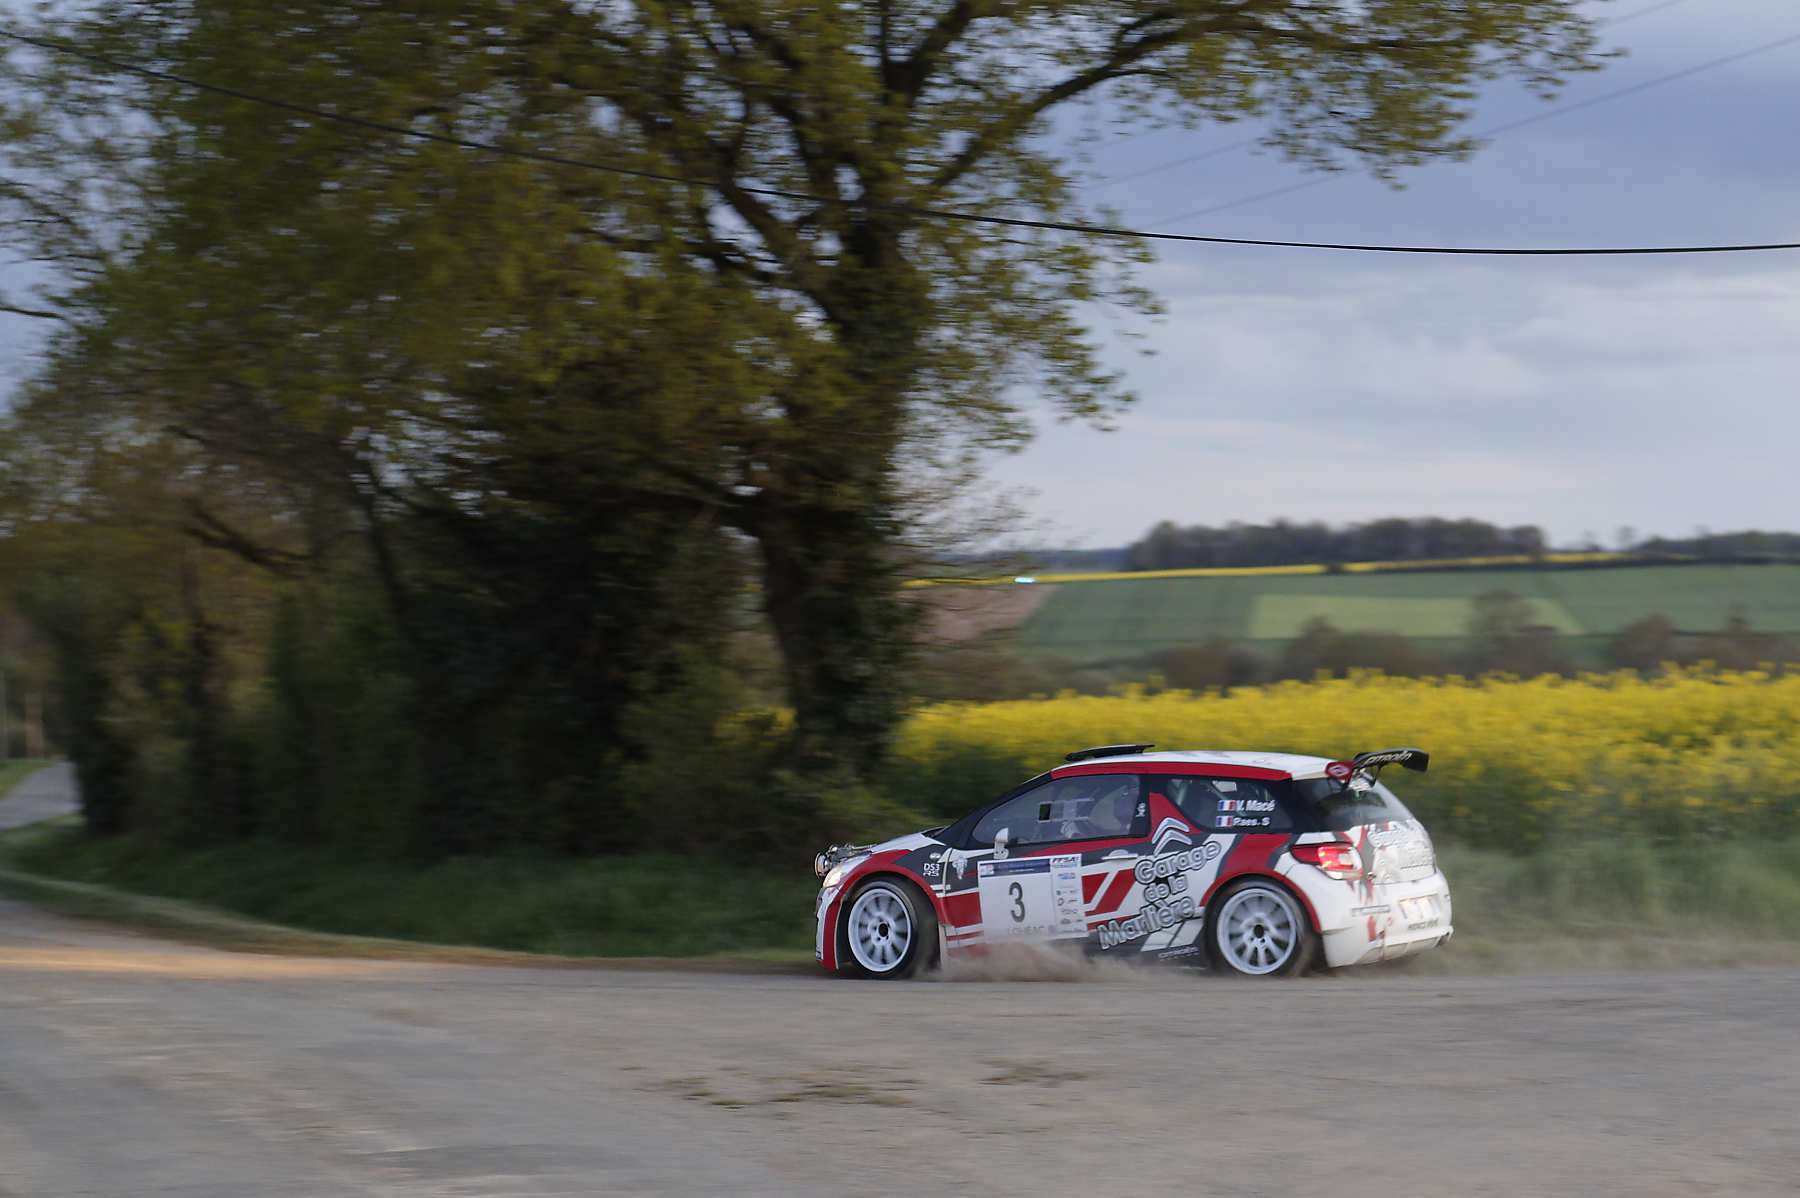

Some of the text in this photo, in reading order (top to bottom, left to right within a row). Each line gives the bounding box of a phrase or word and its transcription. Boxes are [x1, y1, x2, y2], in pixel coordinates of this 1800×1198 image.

[923, 863, 940, 871] DS3
[1135, 842, 1219, 883] Garage
[1008, 881, 1026, 923] 3
[1145, 874, 1187, 902] de la
[1097, 896, 1194, 950] Marlière
